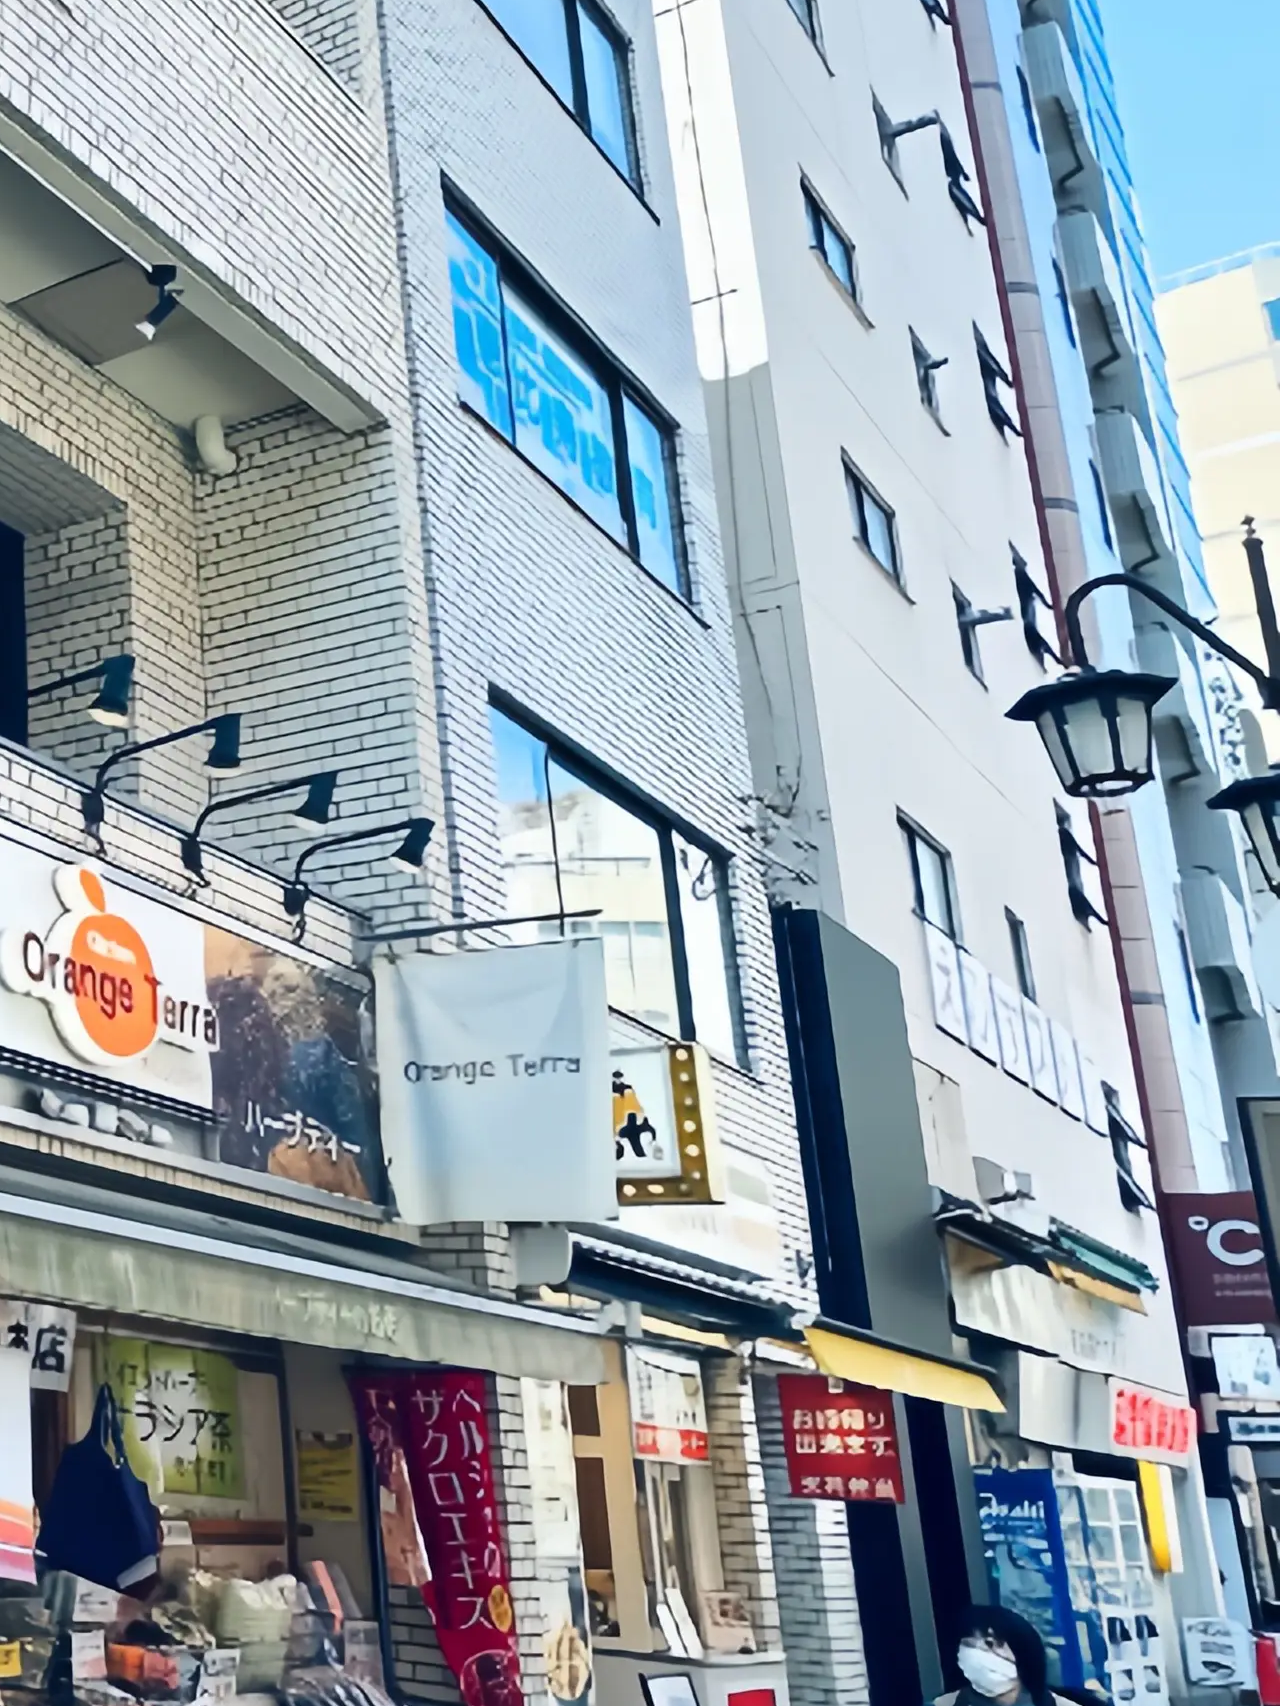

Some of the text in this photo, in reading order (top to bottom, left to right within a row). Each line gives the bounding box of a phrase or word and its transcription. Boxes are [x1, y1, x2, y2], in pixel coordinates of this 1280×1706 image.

[23, 932, 134, 1021] Orange
[143, 973, 218, 1045] Terra
[403, 1051, 582, 1085] Orange Terra
